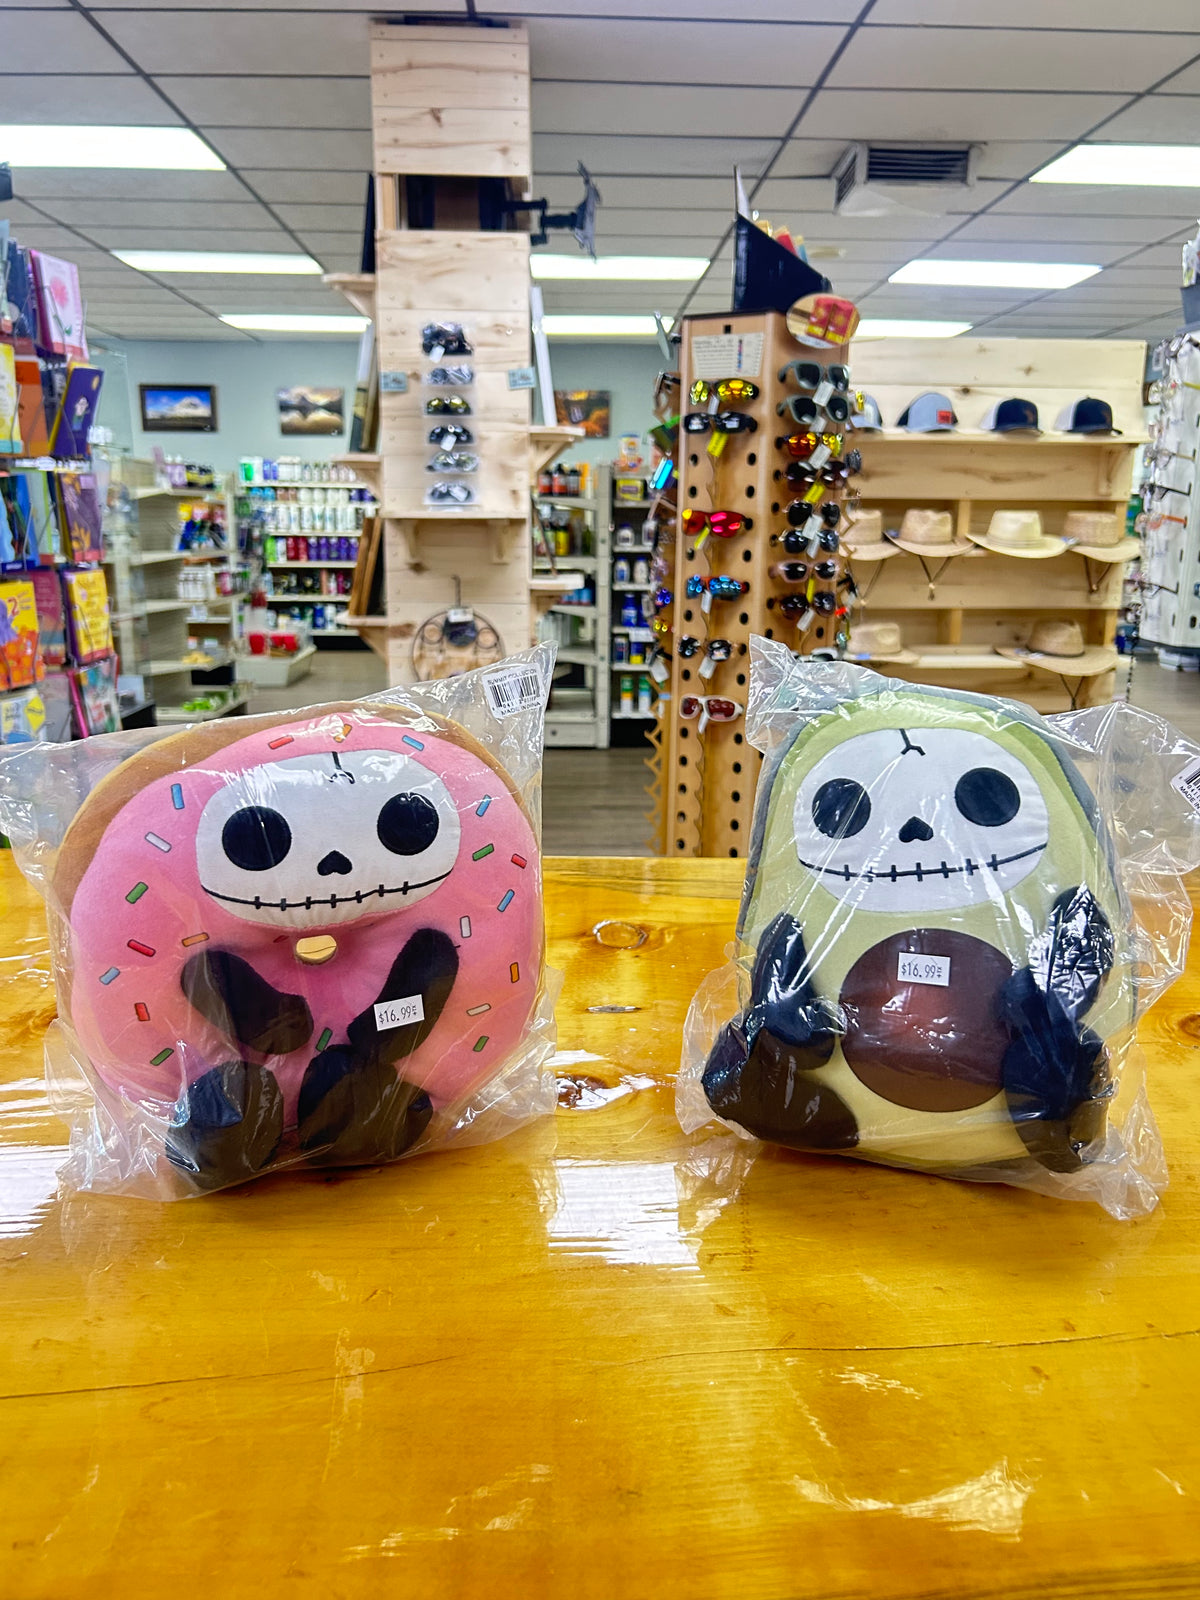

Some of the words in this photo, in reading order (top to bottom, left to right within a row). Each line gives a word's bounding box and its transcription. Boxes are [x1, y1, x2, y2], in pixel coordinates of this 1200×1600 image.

[1179, 786, 1196, 803] MADE
[901, 961, 936, 978] $16.99
[378, 1005, 412, 1025] $16.99
